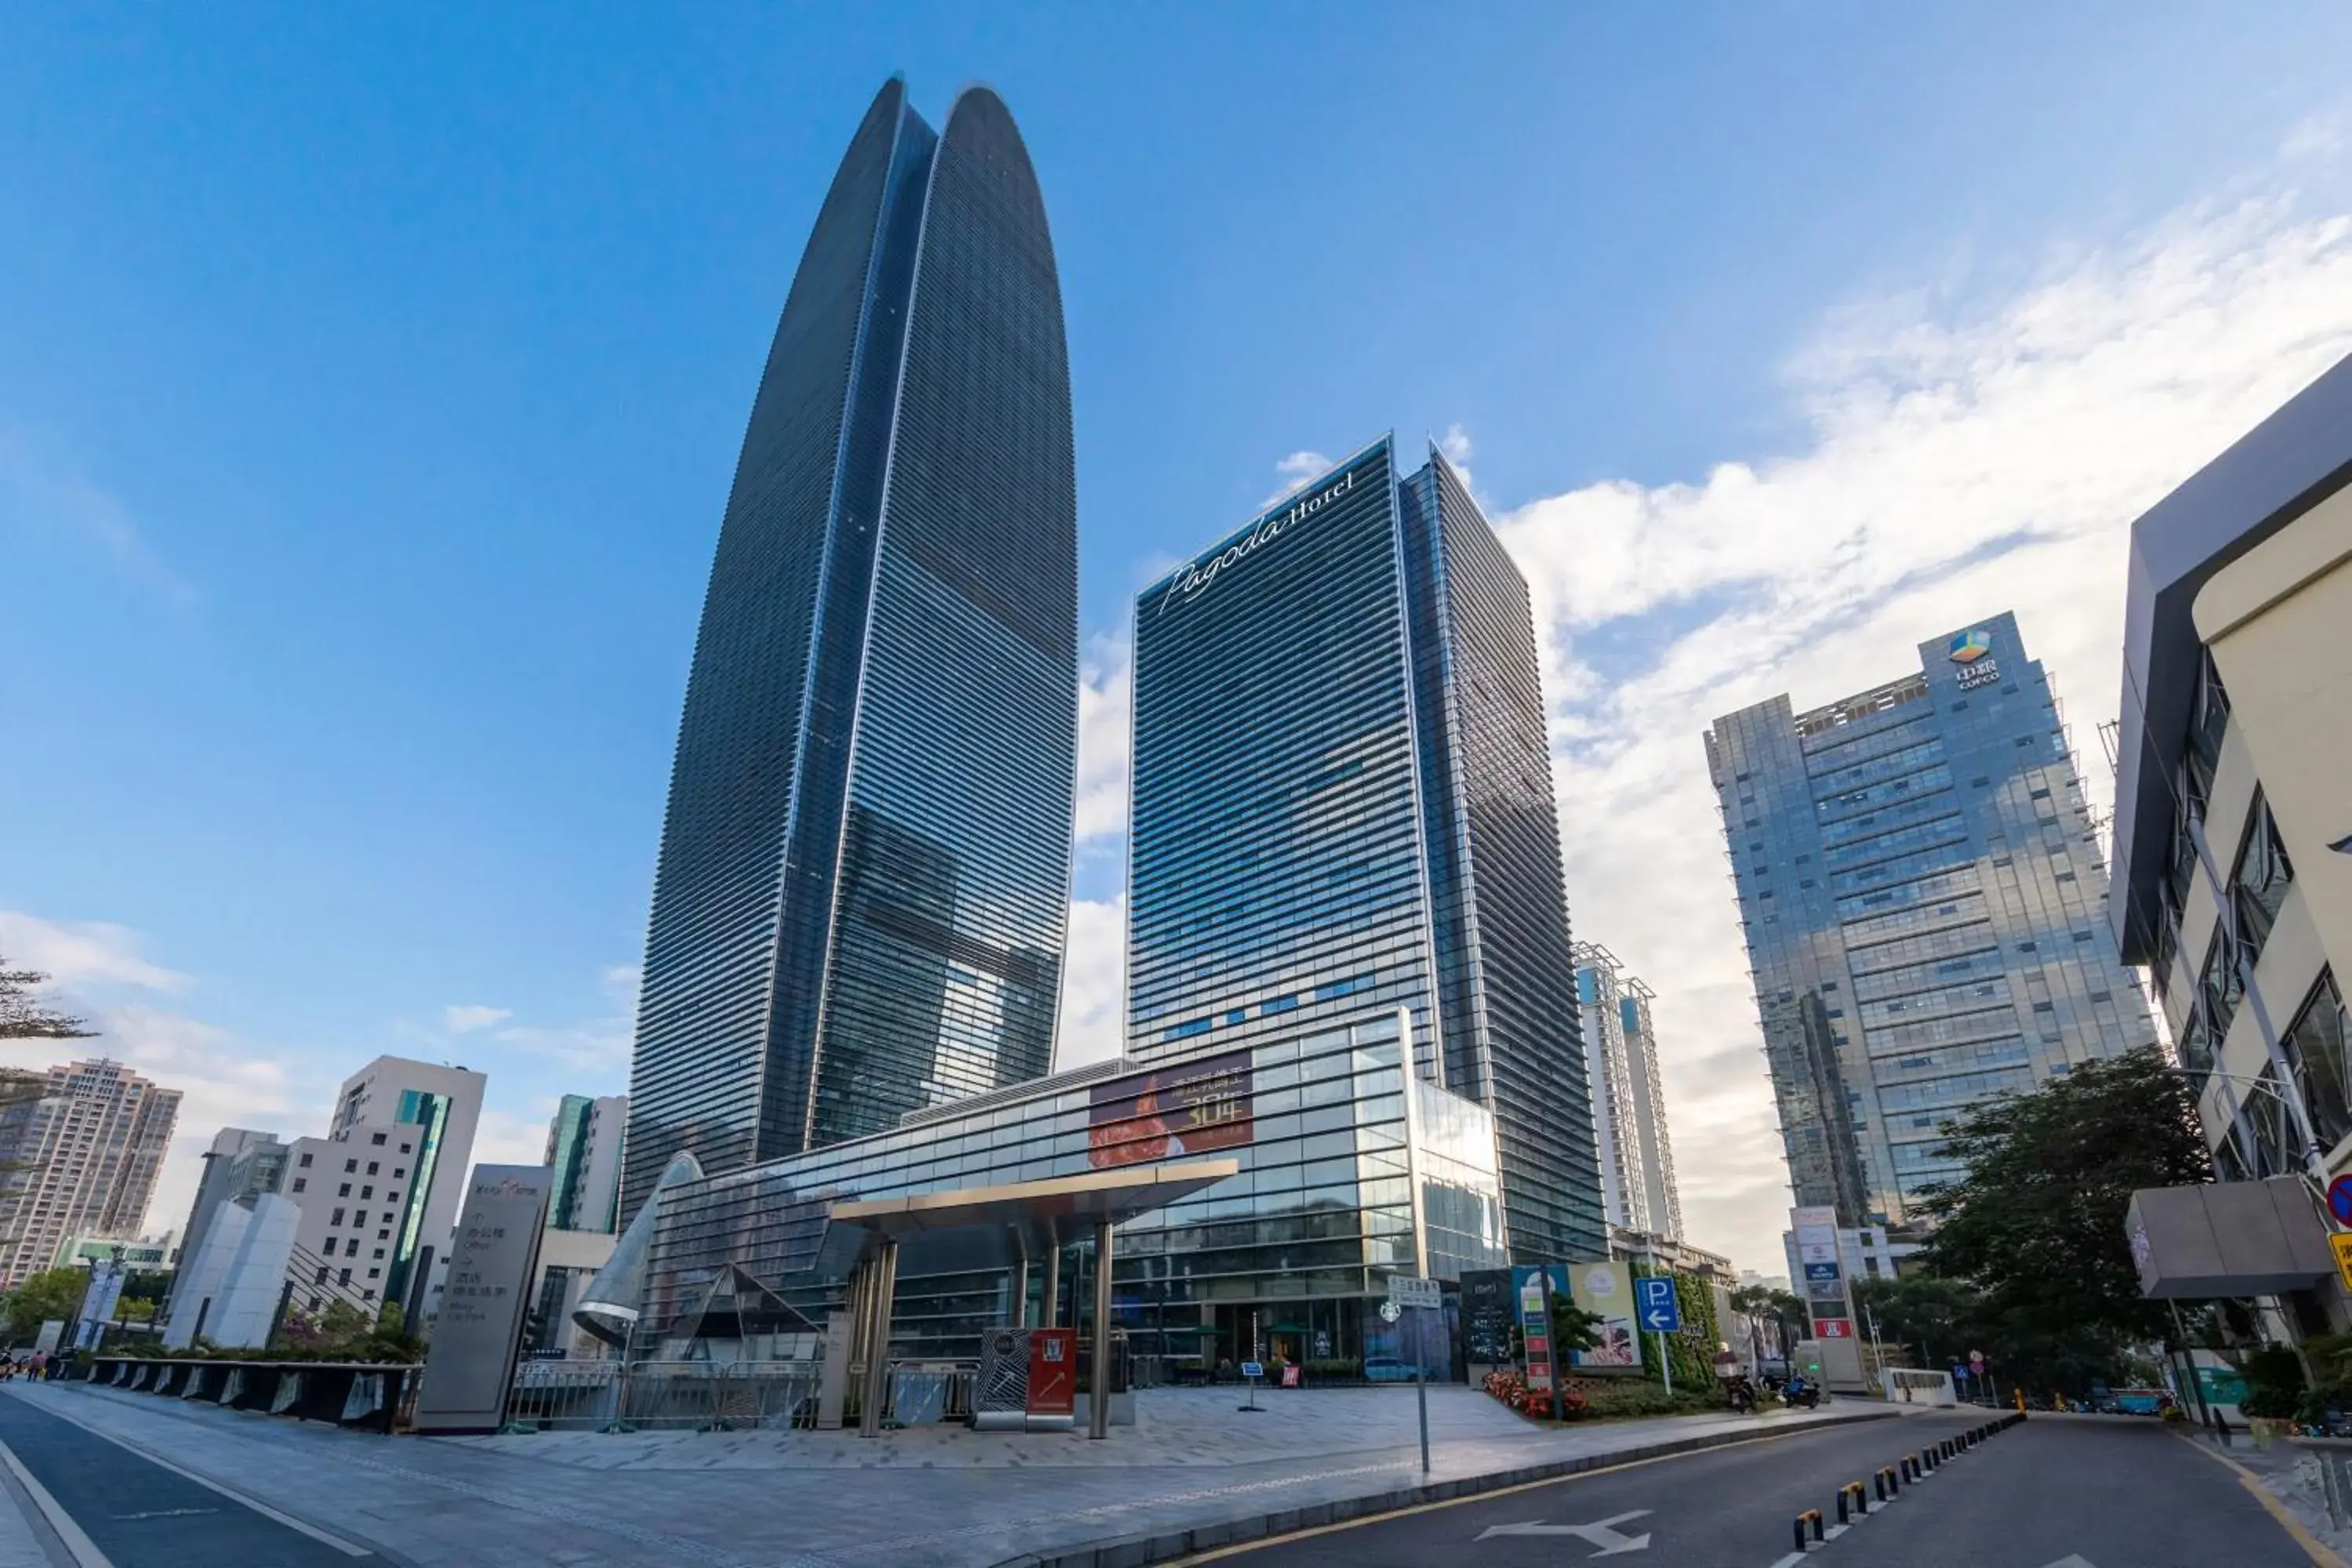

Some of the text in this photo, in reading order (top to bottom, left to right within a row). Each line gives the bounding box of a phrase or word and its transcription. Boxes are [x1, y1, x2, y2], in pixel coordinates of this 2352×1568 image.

[1158, 472, 1353, 615] Pagoda Hotel
[1648, 1282, 1668, 1307] P
